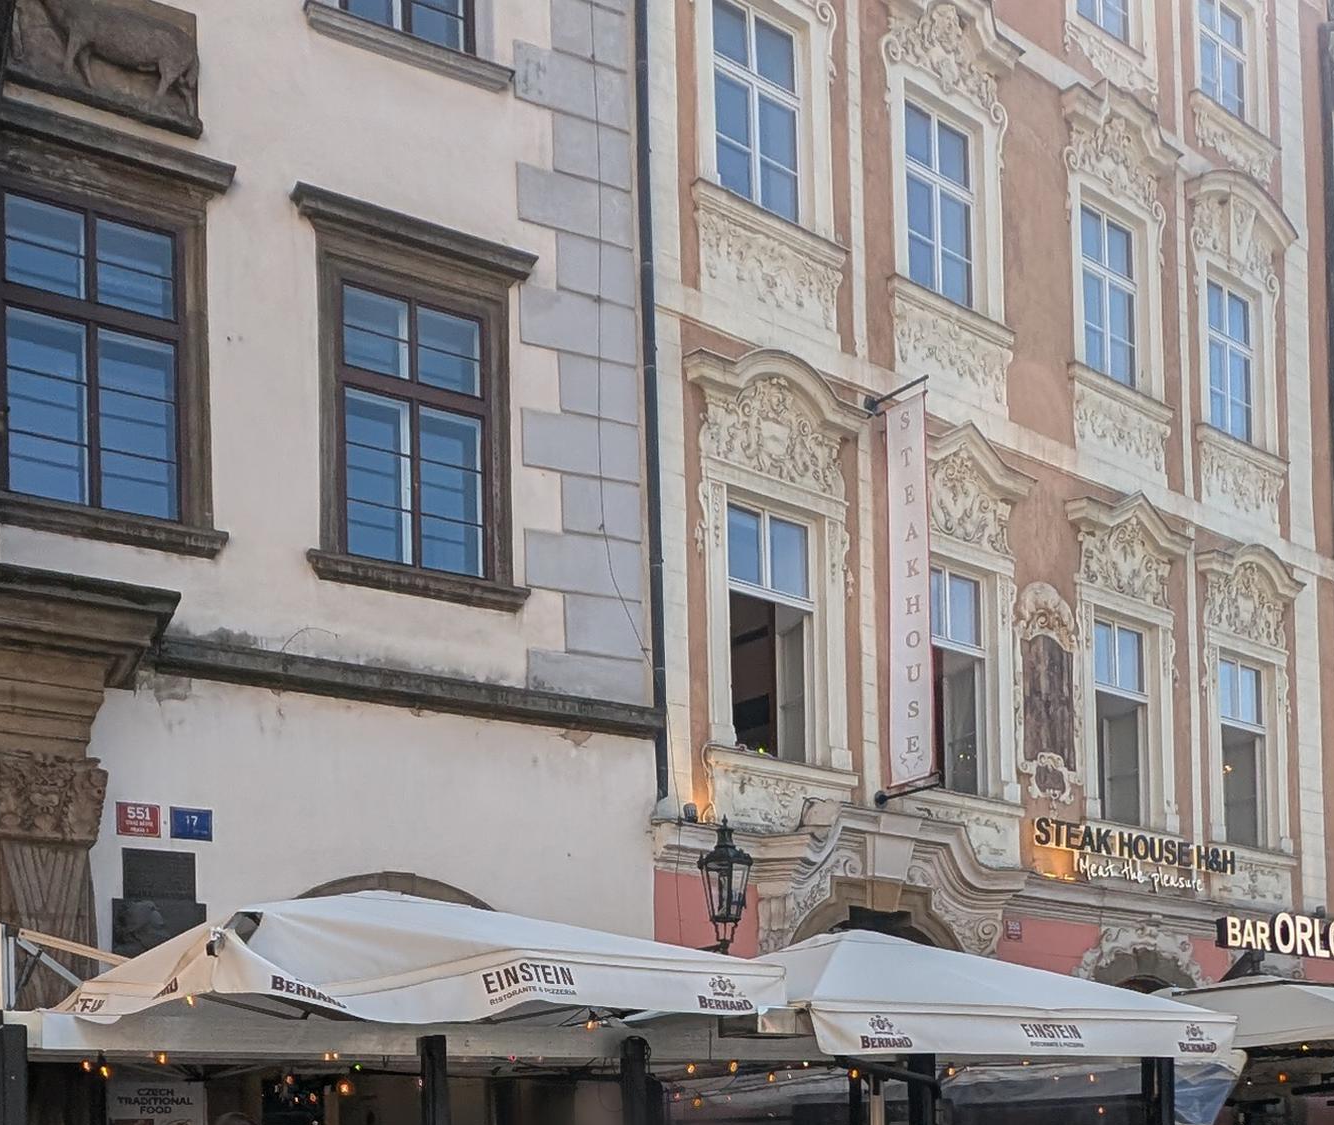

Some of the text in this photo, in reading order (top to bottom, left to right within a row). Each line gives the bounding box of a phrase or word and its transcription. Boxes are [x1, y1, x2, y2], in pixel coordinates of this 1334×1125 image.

[899, 410, 921, 755] STEAKHOUSE
[127, 806, 151, 820] 551
[185, 815, 198, 827] 17
[1034, 817, 1236, 875] STEAK HOUSE H&H
[1073, 850, 1204, 893] Meat the pleasure
[1226, 916, 1271, 951] BAR
[482, 962, 575, 994] EINSTEIN
[489, 985, 537, 1006] RISTORANTE
[697, 995, 754, 1011] BERNARD
[1020, 1023, 1082, 1040] EINSTEIN
[860, 1035, 913, 1049] BERNARD
[137, 1087, 175, 1097] CZECH
[117, 1096, 193, 1106] TRADITIONAL
[139, 1106, 172, 1115] FOOD
